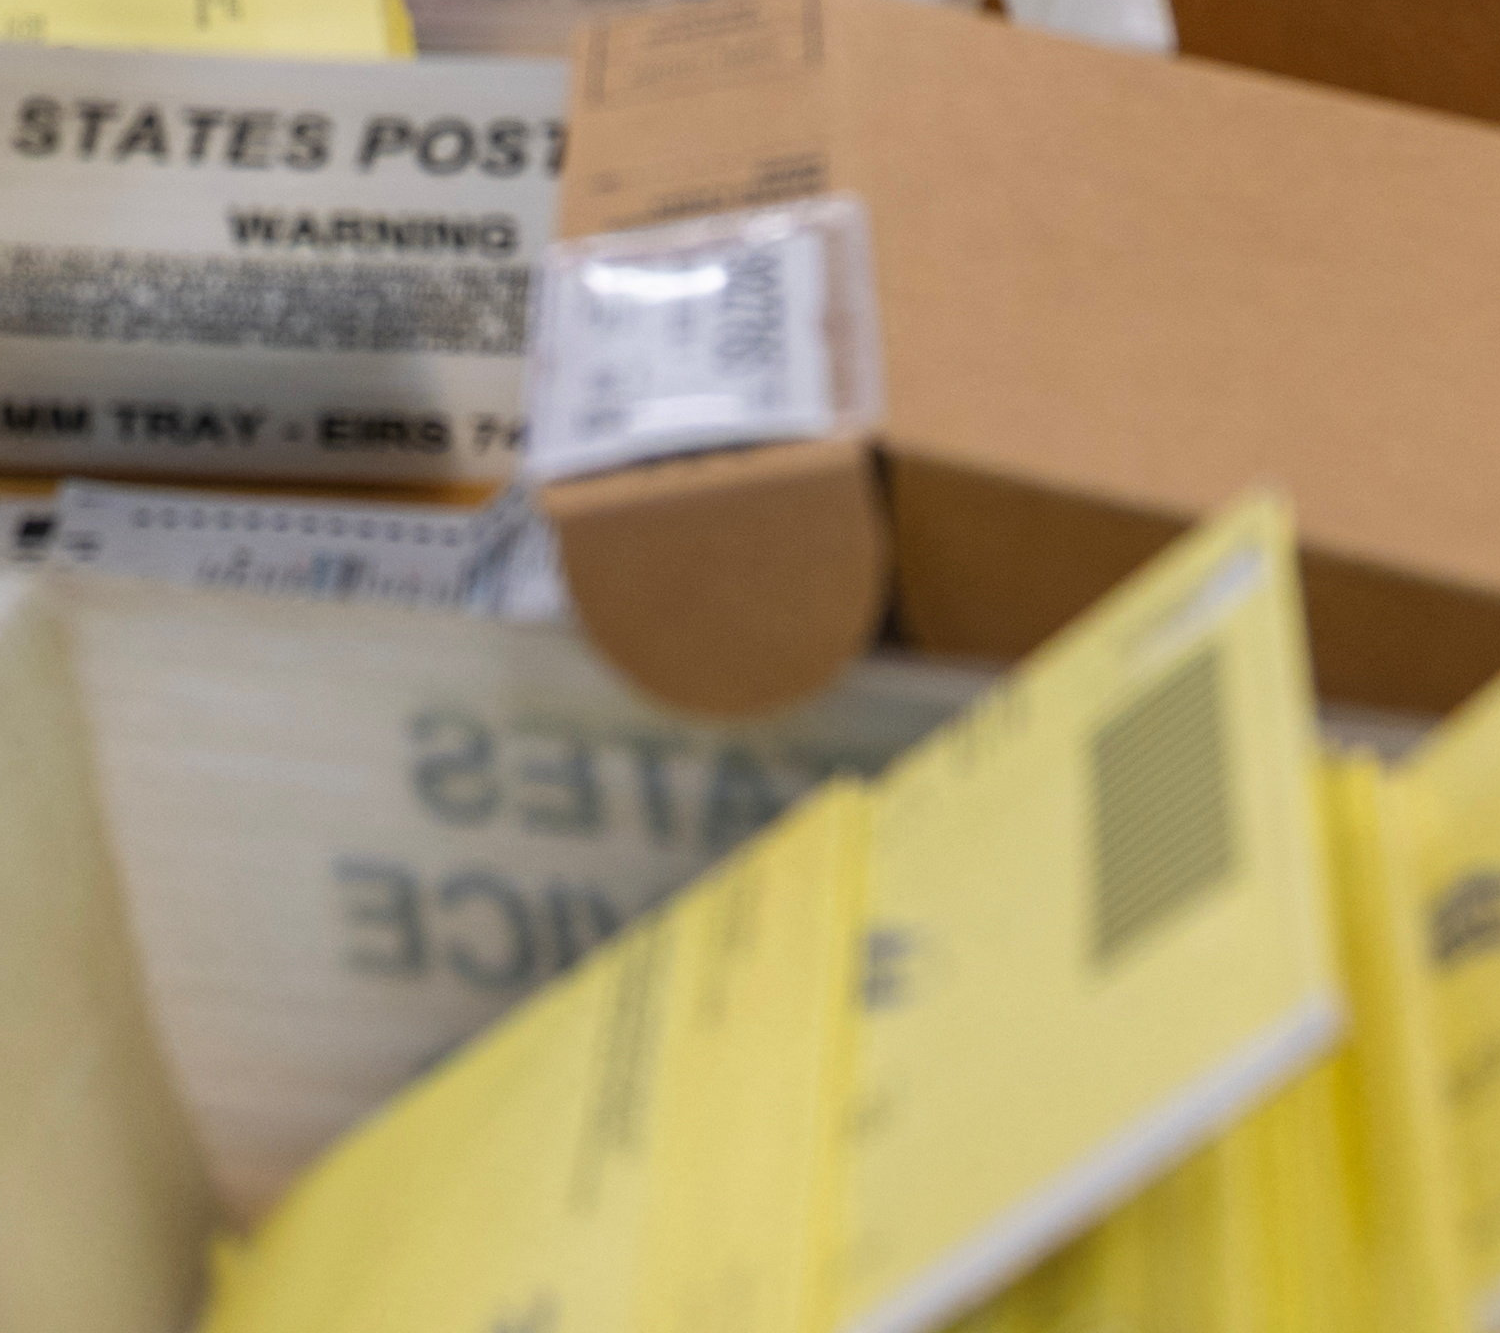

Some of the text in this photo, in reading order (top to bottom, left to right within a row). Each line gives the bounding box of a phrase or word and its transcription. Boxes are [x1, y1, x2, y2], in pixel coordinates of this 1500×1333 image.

[11, 95, 331, 172] STATES
[228, 204, 519, 258] WARNING
[2, 394, 90, 438] MM
[116, 399, 263, 447] TRAY
[318, 412, 450, 454] EIRS
